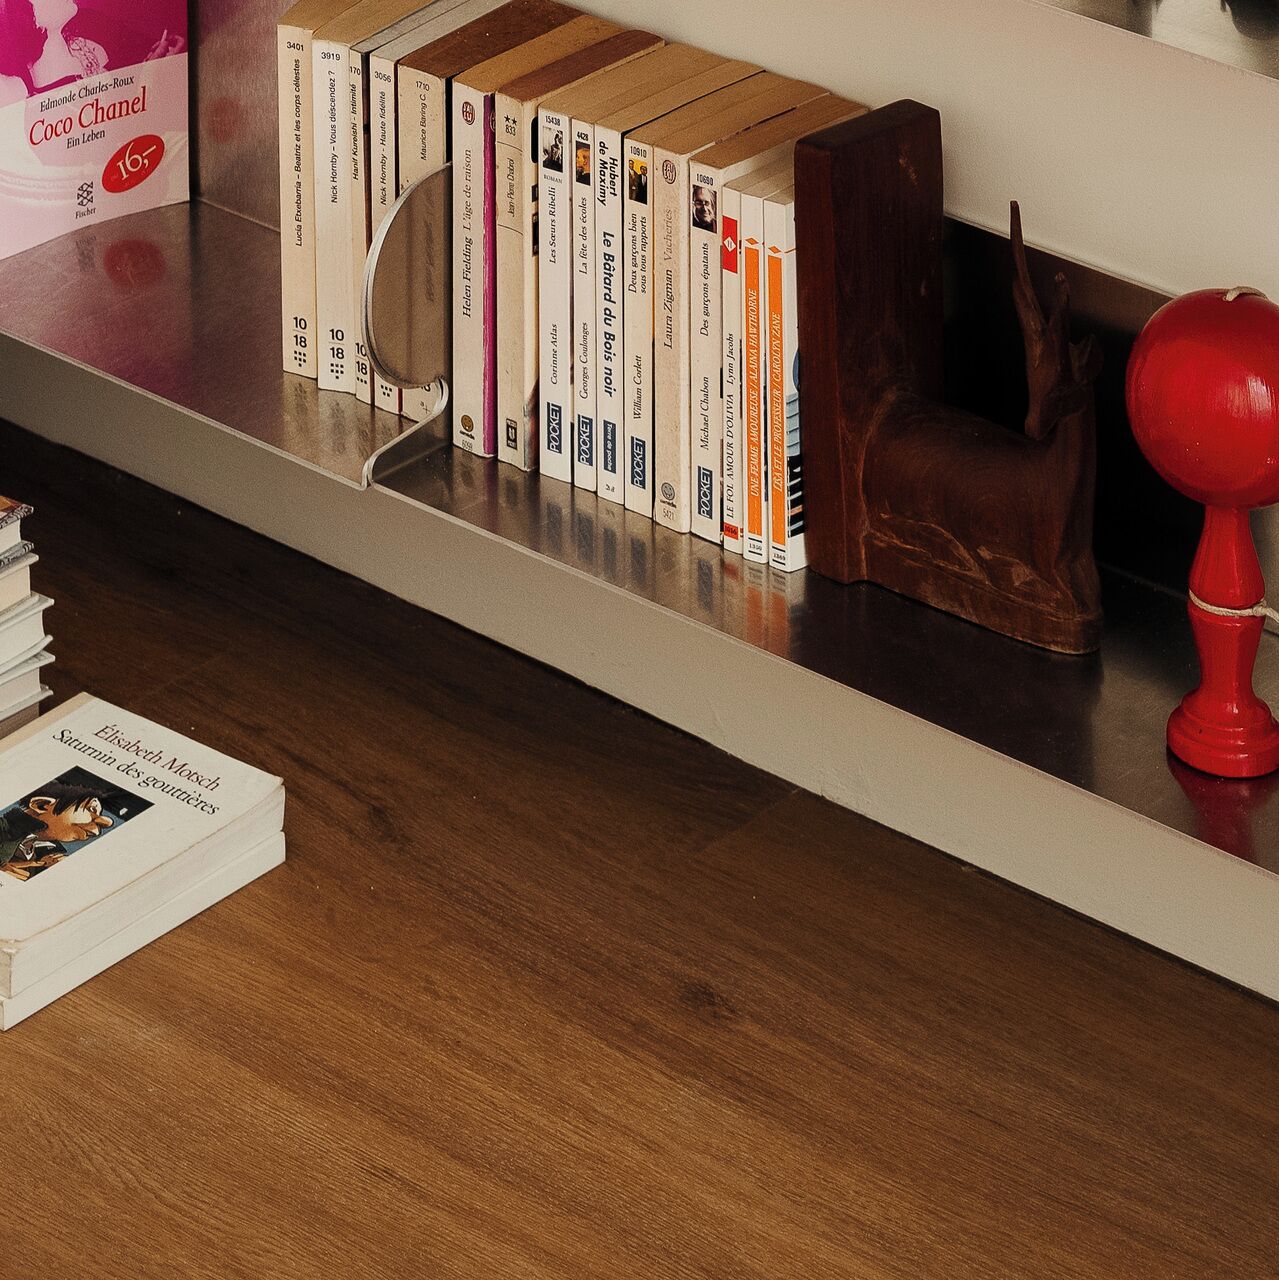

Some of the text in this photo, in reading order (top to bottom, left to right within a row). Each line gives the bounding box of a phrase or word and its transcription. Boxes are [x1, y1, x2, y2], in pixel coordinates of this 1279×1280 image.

[286, 41, 305, 52] 3401
[321, 51, 341, 61] 3919
[40, 74, 135, 112] Edmonde Charles-Roux
[374, 70, 392, 83] 3056
[415, 80, 430, 92] 1710
[29, 85, 148, 146] Coco Chanel
[66, 127, 106, 150] Ein Leben
[505, 123, 516, 136] 833
[545, 115, 561, 127] 15438
[576, 131, 589, 142] 4428
[379, 154, 388, 186] Hornby
[597, 141, 609, 207] de Maximy
[609, 157, 619, 197] Hubert
[630, 145, 648, 159] 10910
[543, 174, 563, 184] ROMAN
[75, 206, 97, 220] Fischer
[462, 149, 474, 319] Helen Fielding L'âge de raison
[548, 187, 557, 264] Les Sœurs Ribelli
[578, 197, 588, 275] La fête des écoles
[628, 213, 638, 294] Deux garçons bien
[663, 208, 675, 350] Laura Zigman Vacheries
[700, 242, 710, 337] Des garçons épatants
[293, 316, 308, 330] 10
[329, 328, 345, 342] 10
[603, 231, 617, 398] Le Bâtard du Bois noir
[293, 334, 308, 348] 18
[330, 346, 345, 360] 18
[550, 323, 558, 385] Corinne Atlas
[579, 322, 589, 400] Georges Coulonges
[355, 360, 368, 375] 18
[633, 355, 642, 421] William Corlett
[748, 288, 759, 497] UNE FEMME AMOUREUSE ALAINA HAWTHORNE
[549, 403, 562, 453] POCKET
[699, 376, 709, 451] Michael Chabon
[725, 332, 736, 520] LE FOL AMOUR D'OLIVIA Lynn Jacobs
[579, 415, 593, 466] POCKET
[632, 438, 646, 490] POCKET
[699, 469, 713, 520] POCKET
[52, 728, 221, 816] Saturnin des gouttières
[93, 723, 222, 792] Élisabeth Motsch
